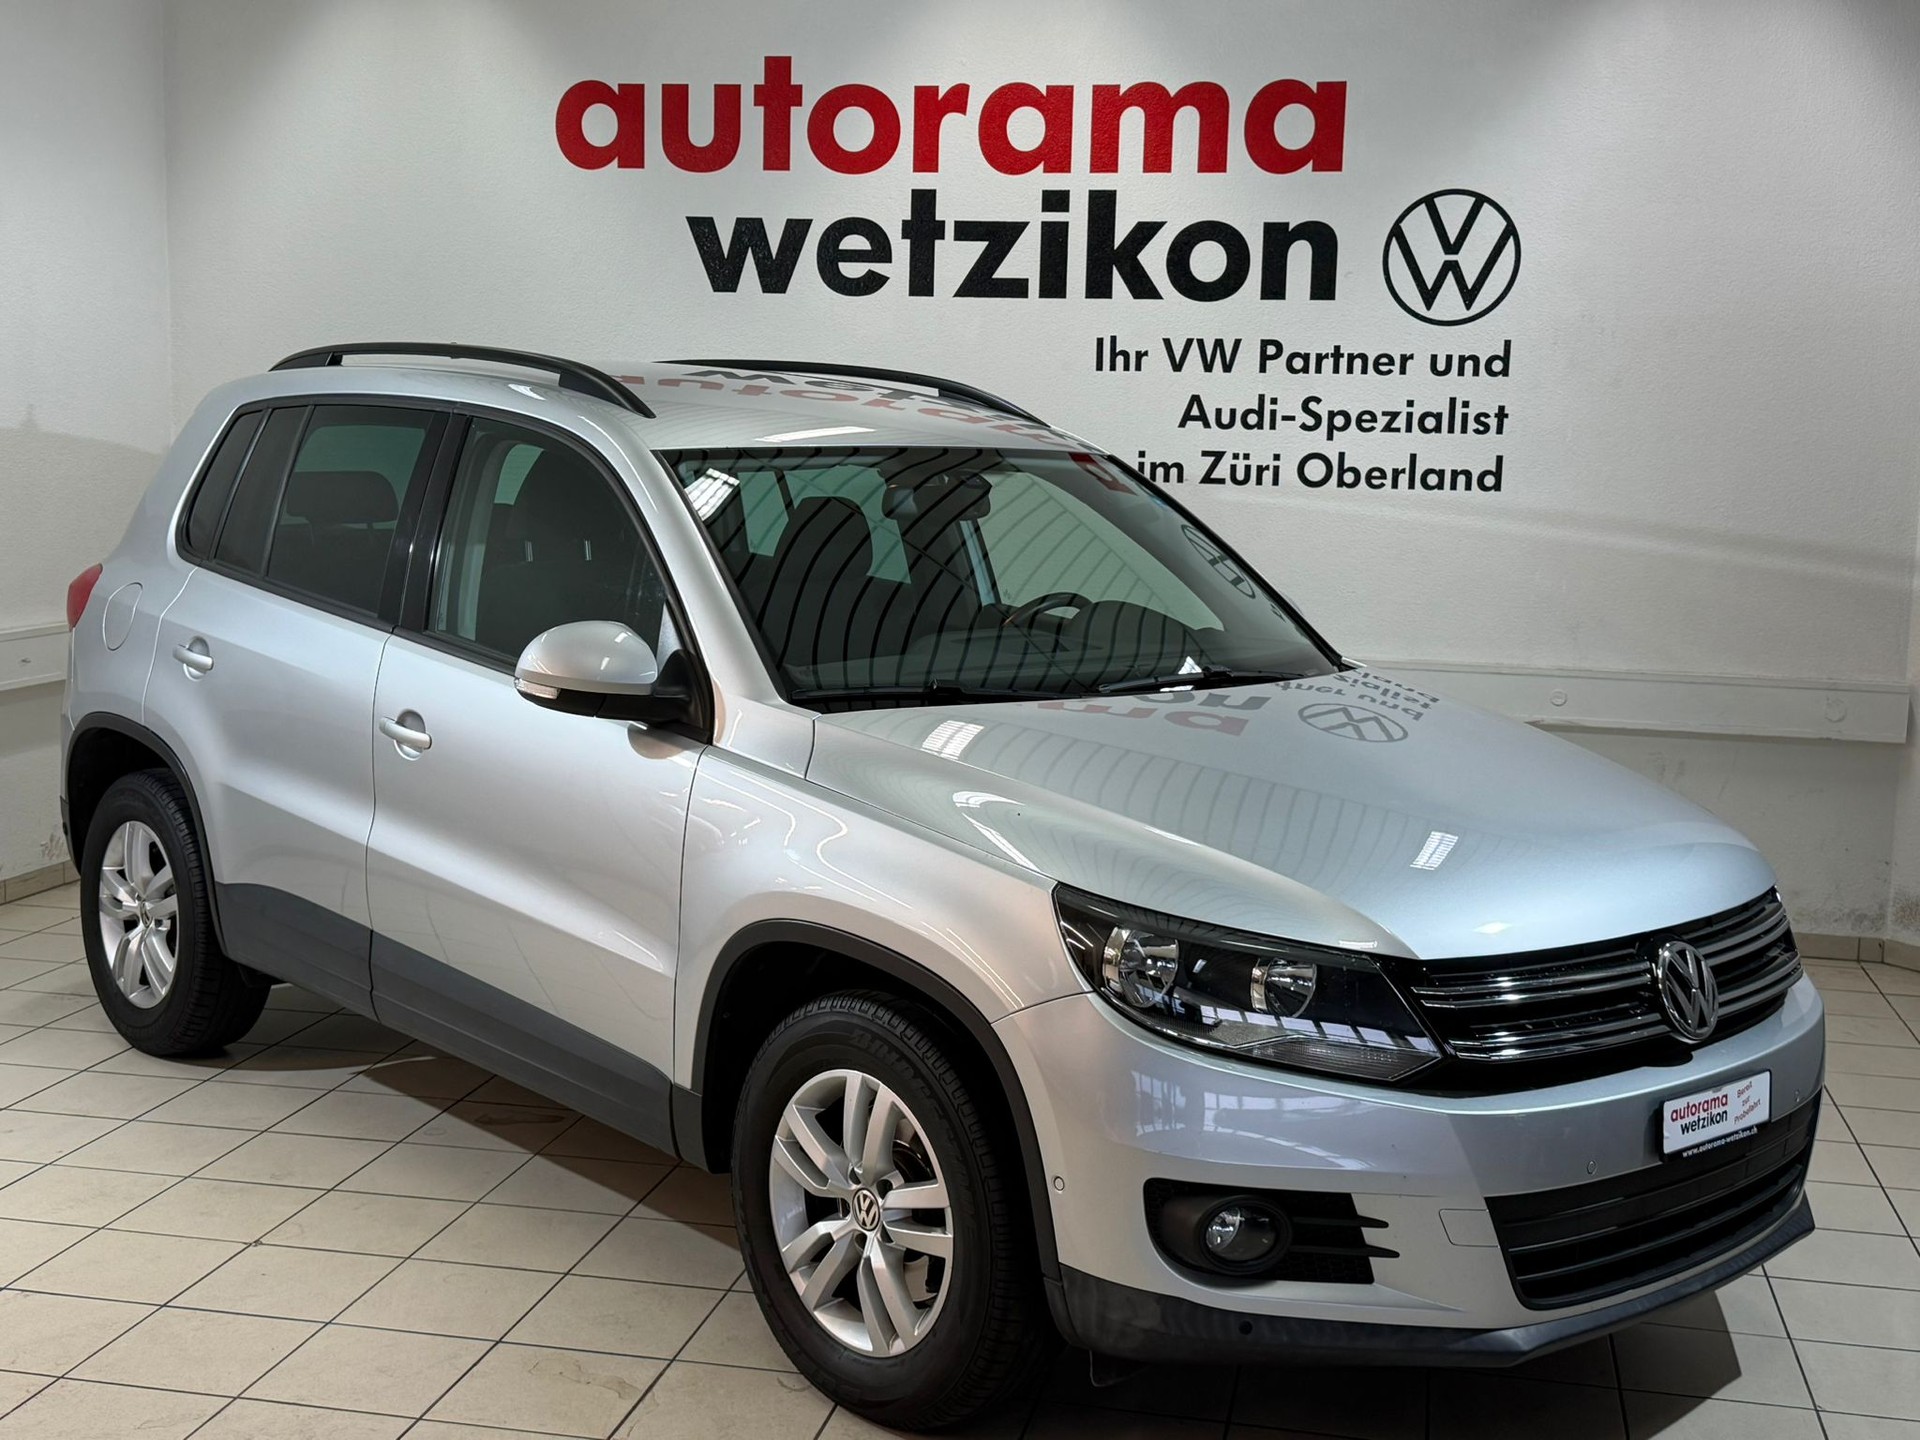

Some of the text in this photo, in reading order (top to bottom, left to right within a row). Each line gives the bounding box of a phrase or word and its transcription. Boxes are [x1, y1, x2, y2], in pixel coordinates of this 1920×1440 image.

[556, 57, 1347, 176] autorama
[686, 189, 1339, 302] wetzikon
[1095, 335, 1513, 378] Ihr VW Partner und
[1177, 393, 1510, 442] Audi-Spezialist
[1138, 450, 1184, 484] im
[1199, 450, 1281, 487] Züri
[1296, 452, 1504, 492] Oberland
[1670, 1093, 1729, 1123] autorama
[1741, 1095, 1751, 1107] zur
[1680, 1109, 1728, 1136] wetzikon
[1682, 1126, 1759, 1158] www.autorama-wetzikon.ch
